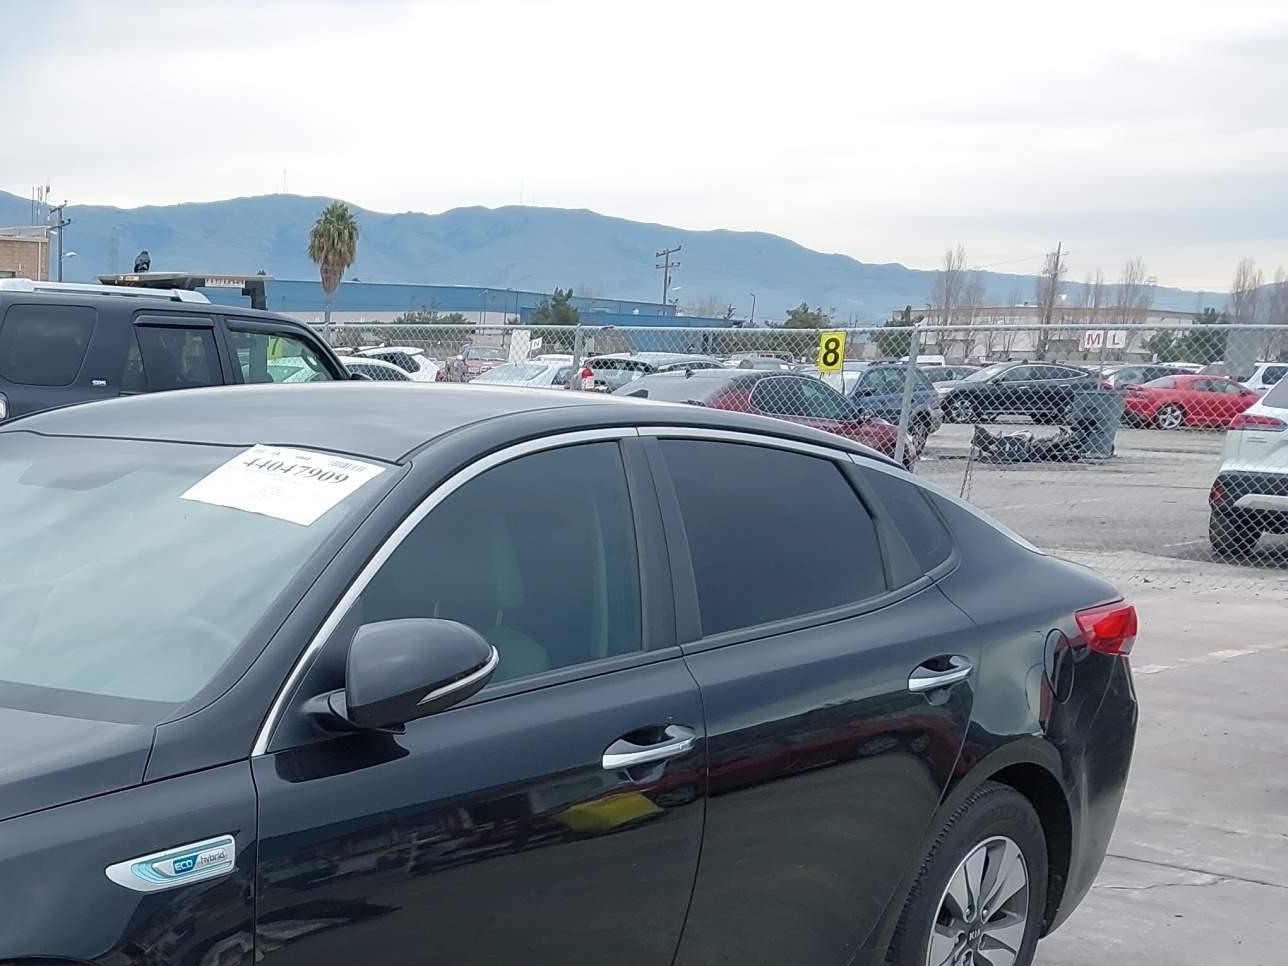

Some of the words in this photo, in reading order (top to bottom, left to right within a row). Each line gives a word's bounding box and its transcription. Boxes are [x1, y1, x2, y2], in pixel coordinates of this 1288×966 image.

[1086, 333, 1101, 345] M
[1112, 333, 1120, 345] L
[822, 337, 841, 367] 8
[243, 457, 349, 484] 44047909
[174, 859, 193, 872] ECO
[199, 850, 225, 866] hybrid
